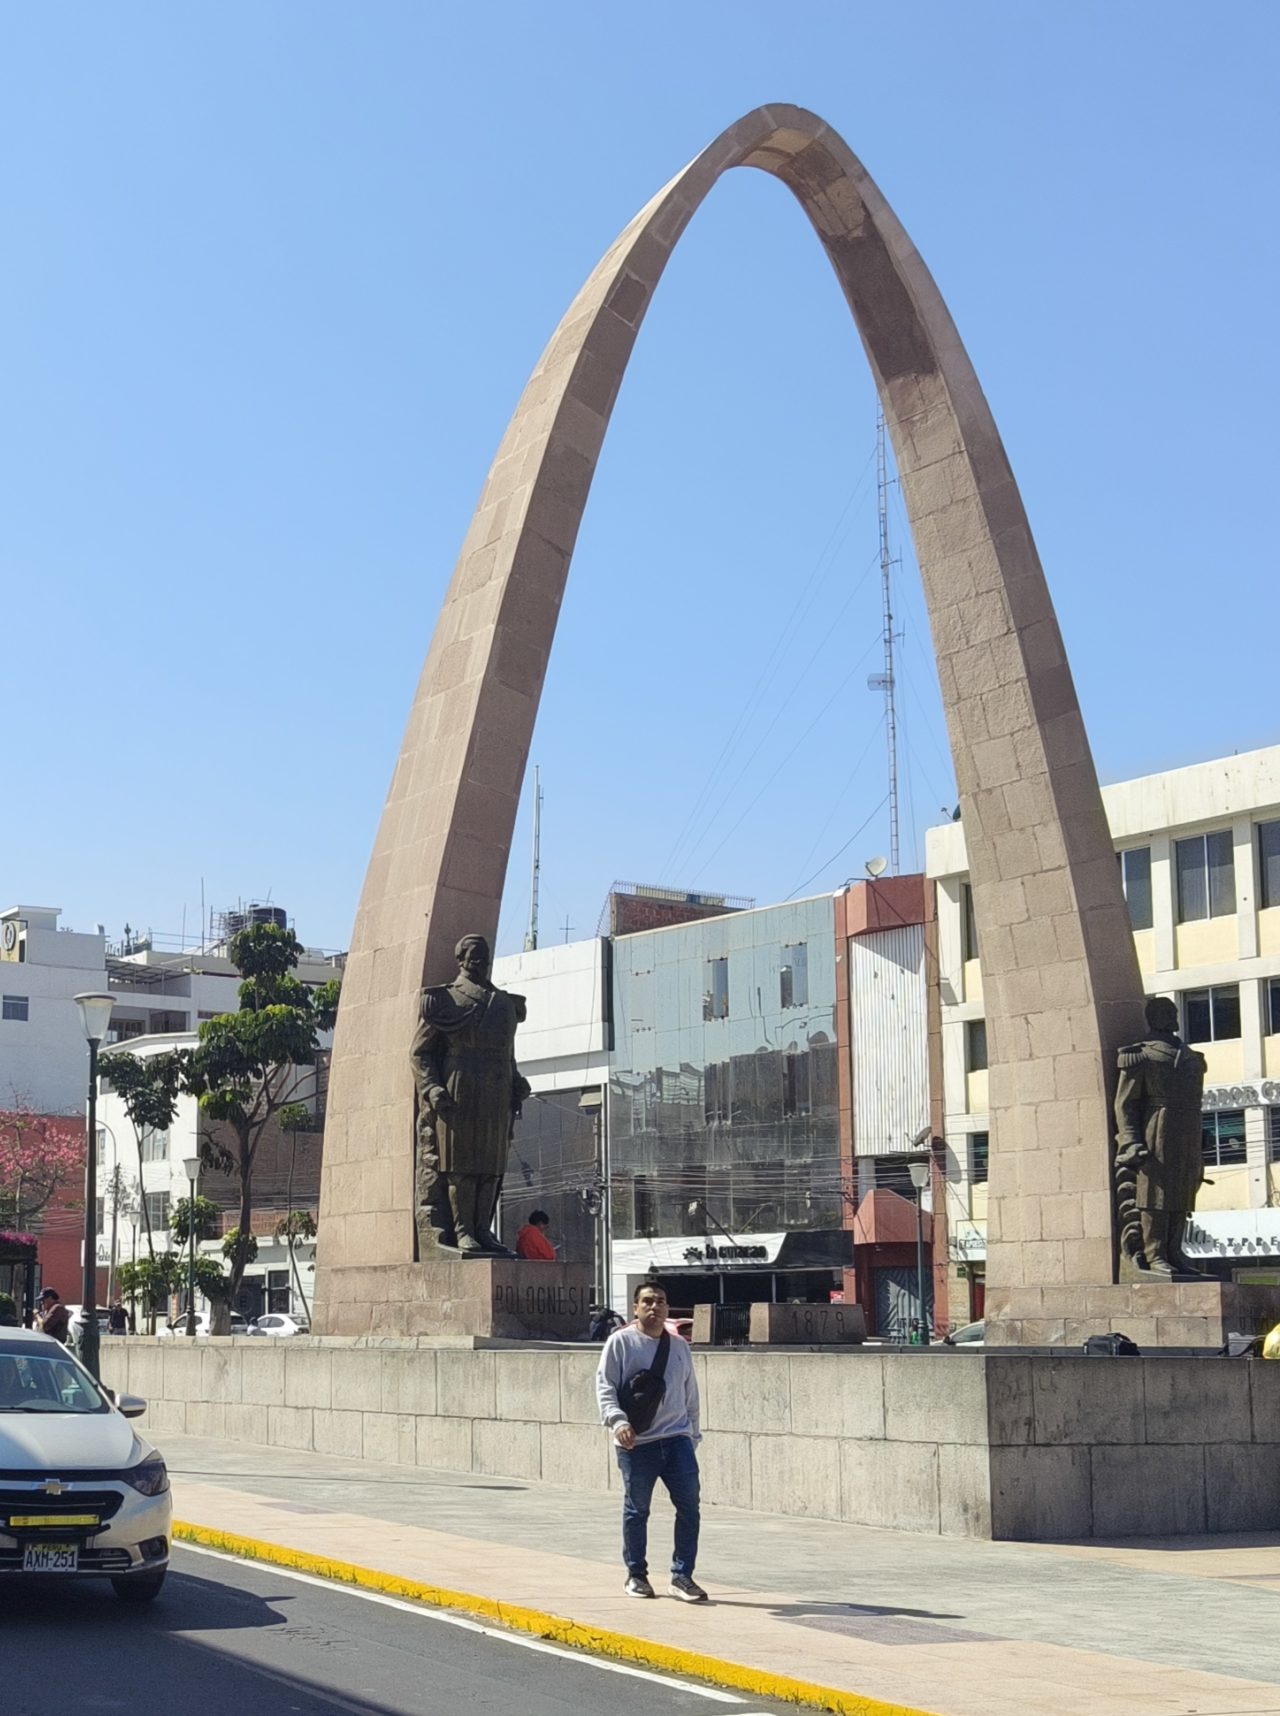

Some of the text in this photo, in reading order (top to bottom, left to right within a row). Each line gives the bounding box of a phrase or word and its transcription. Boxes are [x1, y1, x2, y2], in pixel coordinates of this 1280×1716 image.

[495, 1284, 585, 1316] BOLOGNESI
[791, 1309, 846, 1335] 1879
[25, 1550, 76, 1568] AXM-251
